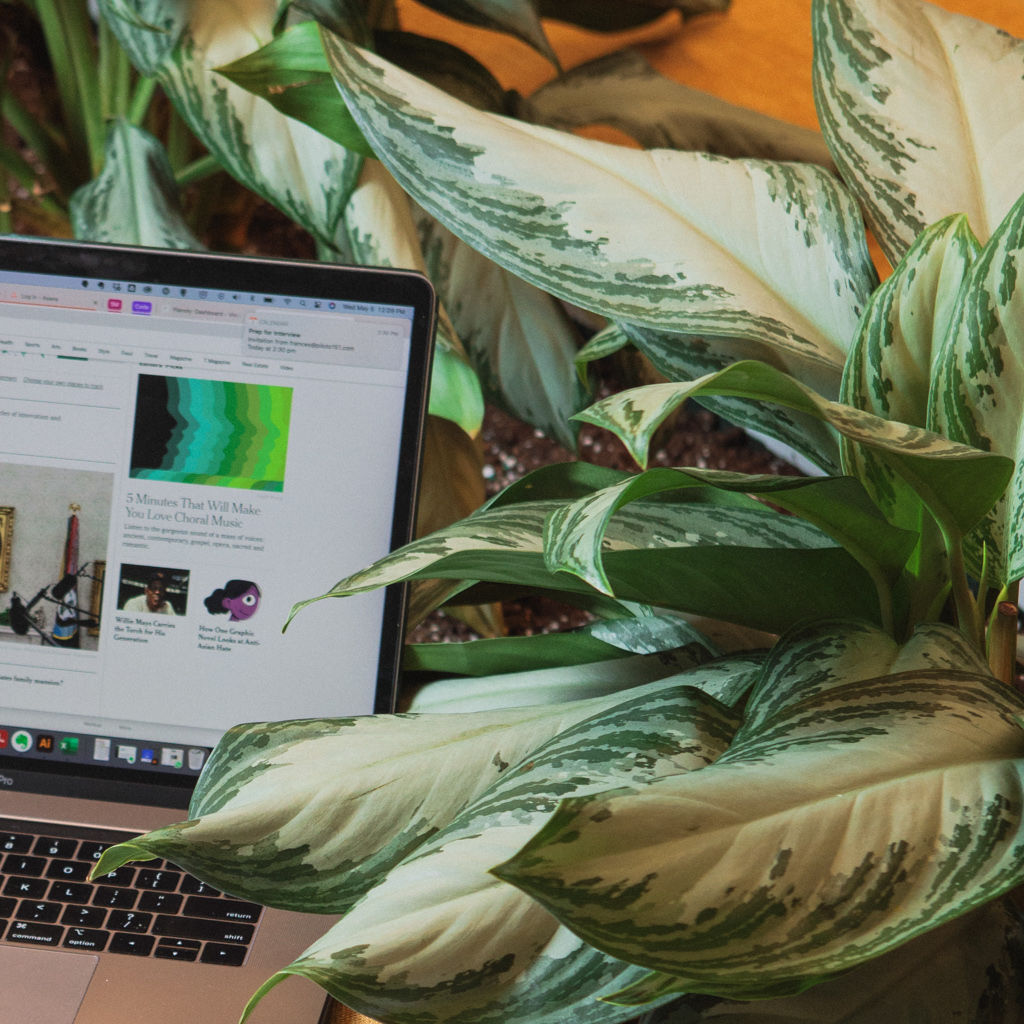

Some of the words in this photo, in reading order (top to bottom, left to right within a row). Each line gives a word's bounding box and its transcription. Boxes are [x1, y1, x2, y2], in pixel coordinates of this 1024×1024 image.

[135, 303, 150, 311] Code
[126, 493, 134, 503] 5
[135, 494, 178, 508] Minutes
[180, 498, 204, 510] That
[207, 500, 229, 513] Will
[231, 503, 261, 516] Make
[126, 507, 144, 519] You
[147, 510, 172, 522] Love
[174, 512, 209, 525] Choral
[211, 515, 244, 529] Music
[136, 618, 152, 627] Mays
[153, 620, 175, 628] Carries
[126, 626, 144, 634] Torch
[144, 628, 154, 636] for
[229, 628, 254, 637] Graphic
[113, 634, 148, 643] Generation
[198, 634, 216, 642] Novel
[218, 636, 236, 644] Looks
[244, 638, 261, 646] Anti-
[197, 643, 214, 651] Asian
[13, 674, 33, 685] family
[39, 738, 51, 748] Ai
[12, 932, 52, 942] command
[69, 939, 95, 947] option
